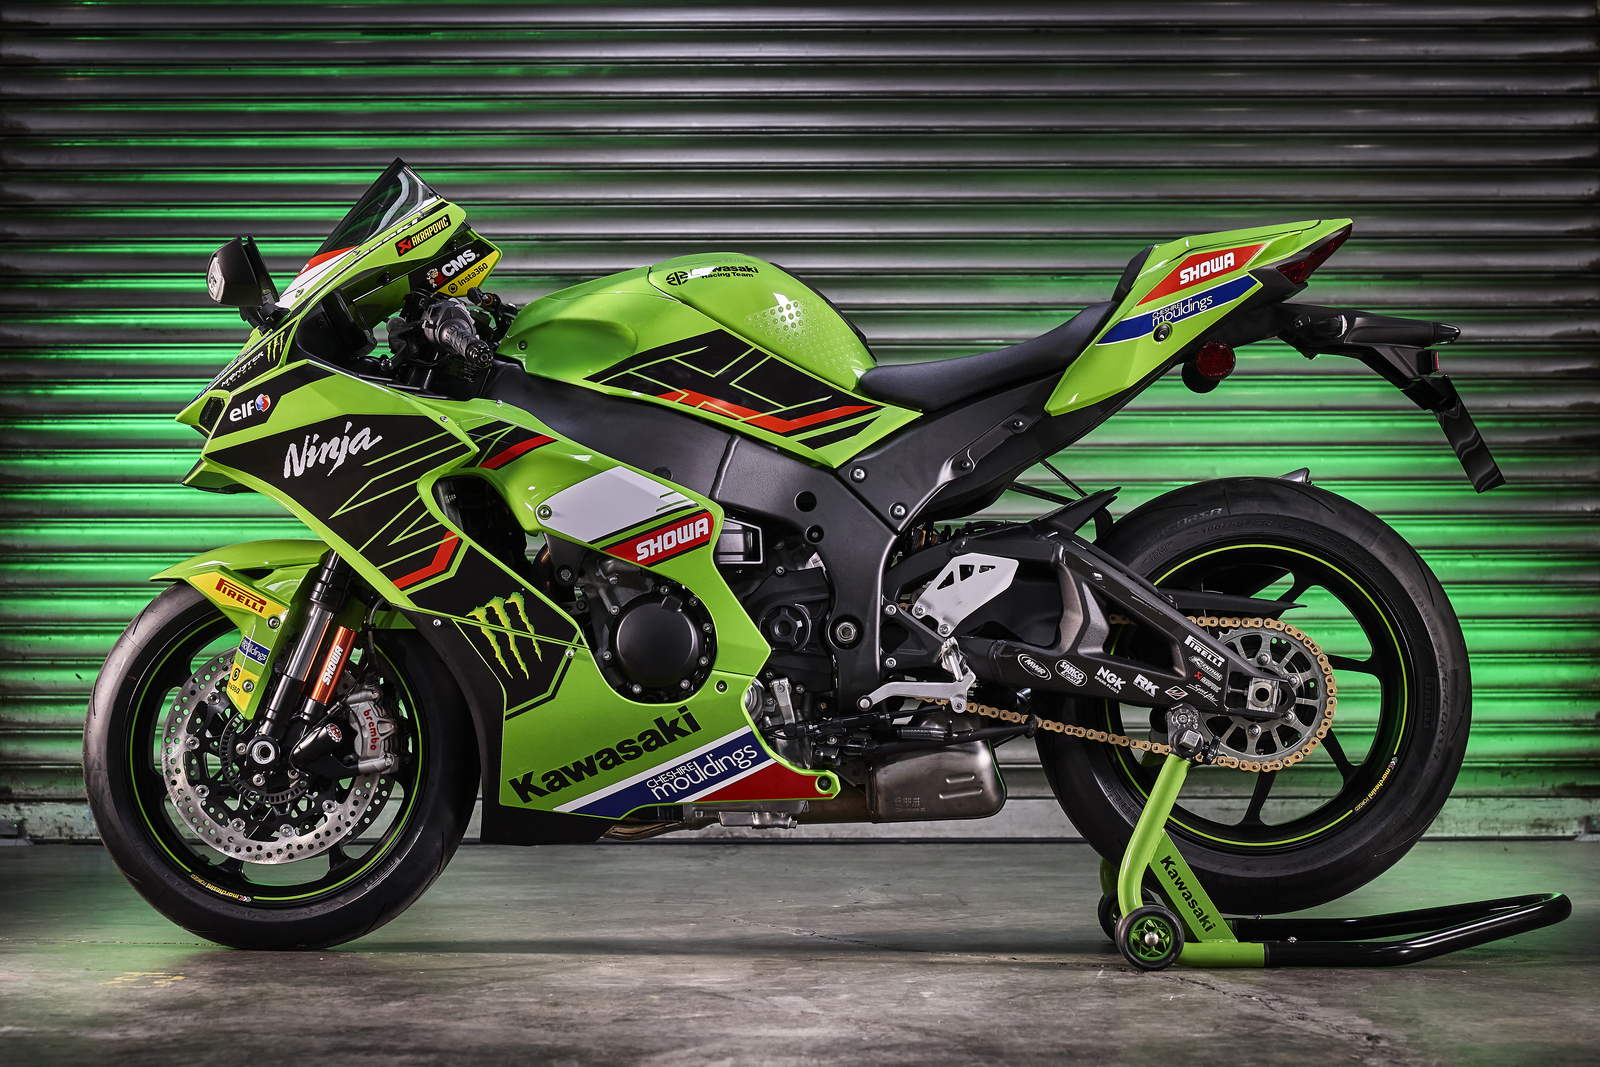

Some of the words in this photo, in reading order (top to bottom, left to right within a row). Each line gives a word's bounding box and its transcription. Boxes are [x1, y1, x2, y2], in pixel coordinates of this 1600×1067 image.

[411, 216, 449, 247] AKRAPOVIC
[441, 249, 477, 277] CMS
[458, 262, 489, 287] Insta360
[690, 265, 759, 275] wasaki
[1179, 252, 1235, 285] SHOWA
[1152, 296, 1213, 327] mouldings
[229, 400, 255, 422] elf
[283, 421, 383, 479] Ninja
[636, 517, 709, 561] SHOWA
[215, 577, 267, 613] PIRELLI
[322, 645, 344, 686] SHOWA
[1184, 634, 1225, 667] PIRELLI
[1096, 666, 1126, 690] NGK
[1133, 674, 1160, 697] RK
[363, 709, 380, 751] brembo
[508, 705, 703, 804] Kawasaki
[646, 760, 696, 789] CHESHIRE
[651, 744, 757, 800] mouldings
[1160, 855, 1217, 933] Kawasaki
